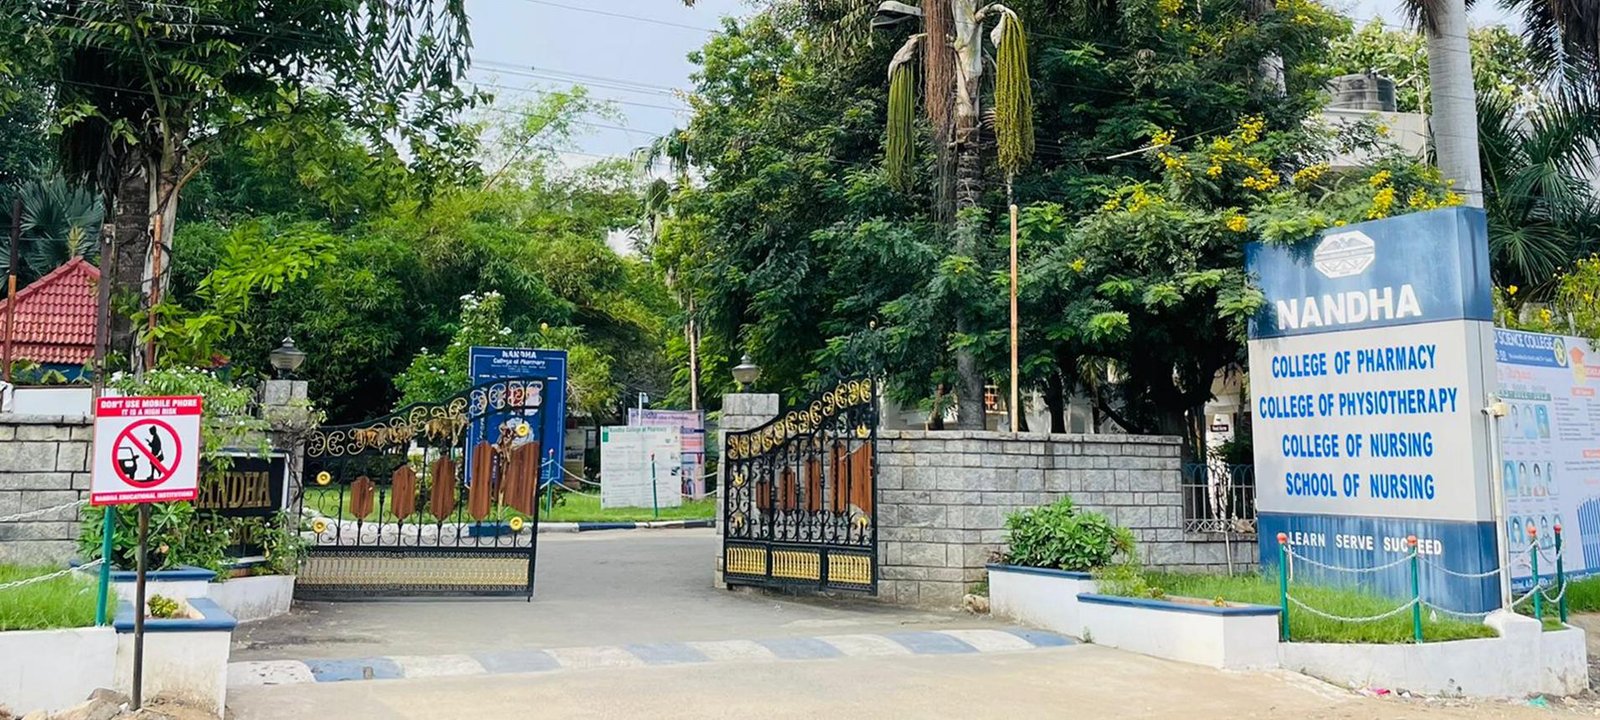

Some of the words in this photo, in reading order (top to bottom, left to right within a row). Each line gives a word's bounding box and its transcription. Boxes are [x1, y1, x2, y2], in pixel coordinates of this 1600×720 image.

[1277, 284, 1422, 330] NANDHA
[1498, 331, 1524, 347] SCIENCE
[1524, 334, 1554, 350] COLLEGE
[493, 358, 513, 366] College
[520, 359, 545, 367] Pharmacy
[502, 350, 537, 359] NANDHA
[1272, 353, 1327, 378] COLLEGE
[1334, 351, 1350, 375] OF
[1357, 345, 1436, 373] PHARMACY
[101, 400, 123, 409] DON'T
[125, 400, 140, 408] USE
[142, 400, 170, 408] MOBILE
[172, 399, 198, 407] PHONE
[1259, 395, 1314, 419] COLLEGE
[1319, 393, 1334, 416] OF
[1339, 387, 1457, 416] PHYSIOTHERAPY
[1282, 434, 1339, 458] COLLEGE
[1346, 434, 1362, 457] OF
[1370, 432, 1433, 457] NURSING
[1286, 472, 1337, 497] SCHOOL
[1343, 473, 1360, 497] OF
[1370, 474, 1435, 500] NURSING
[1289, 532, 1325, 548] LEARN
[1335, 535, 1374, 550] SERVE
[1383, 536, 1442, 555] SUCEED
